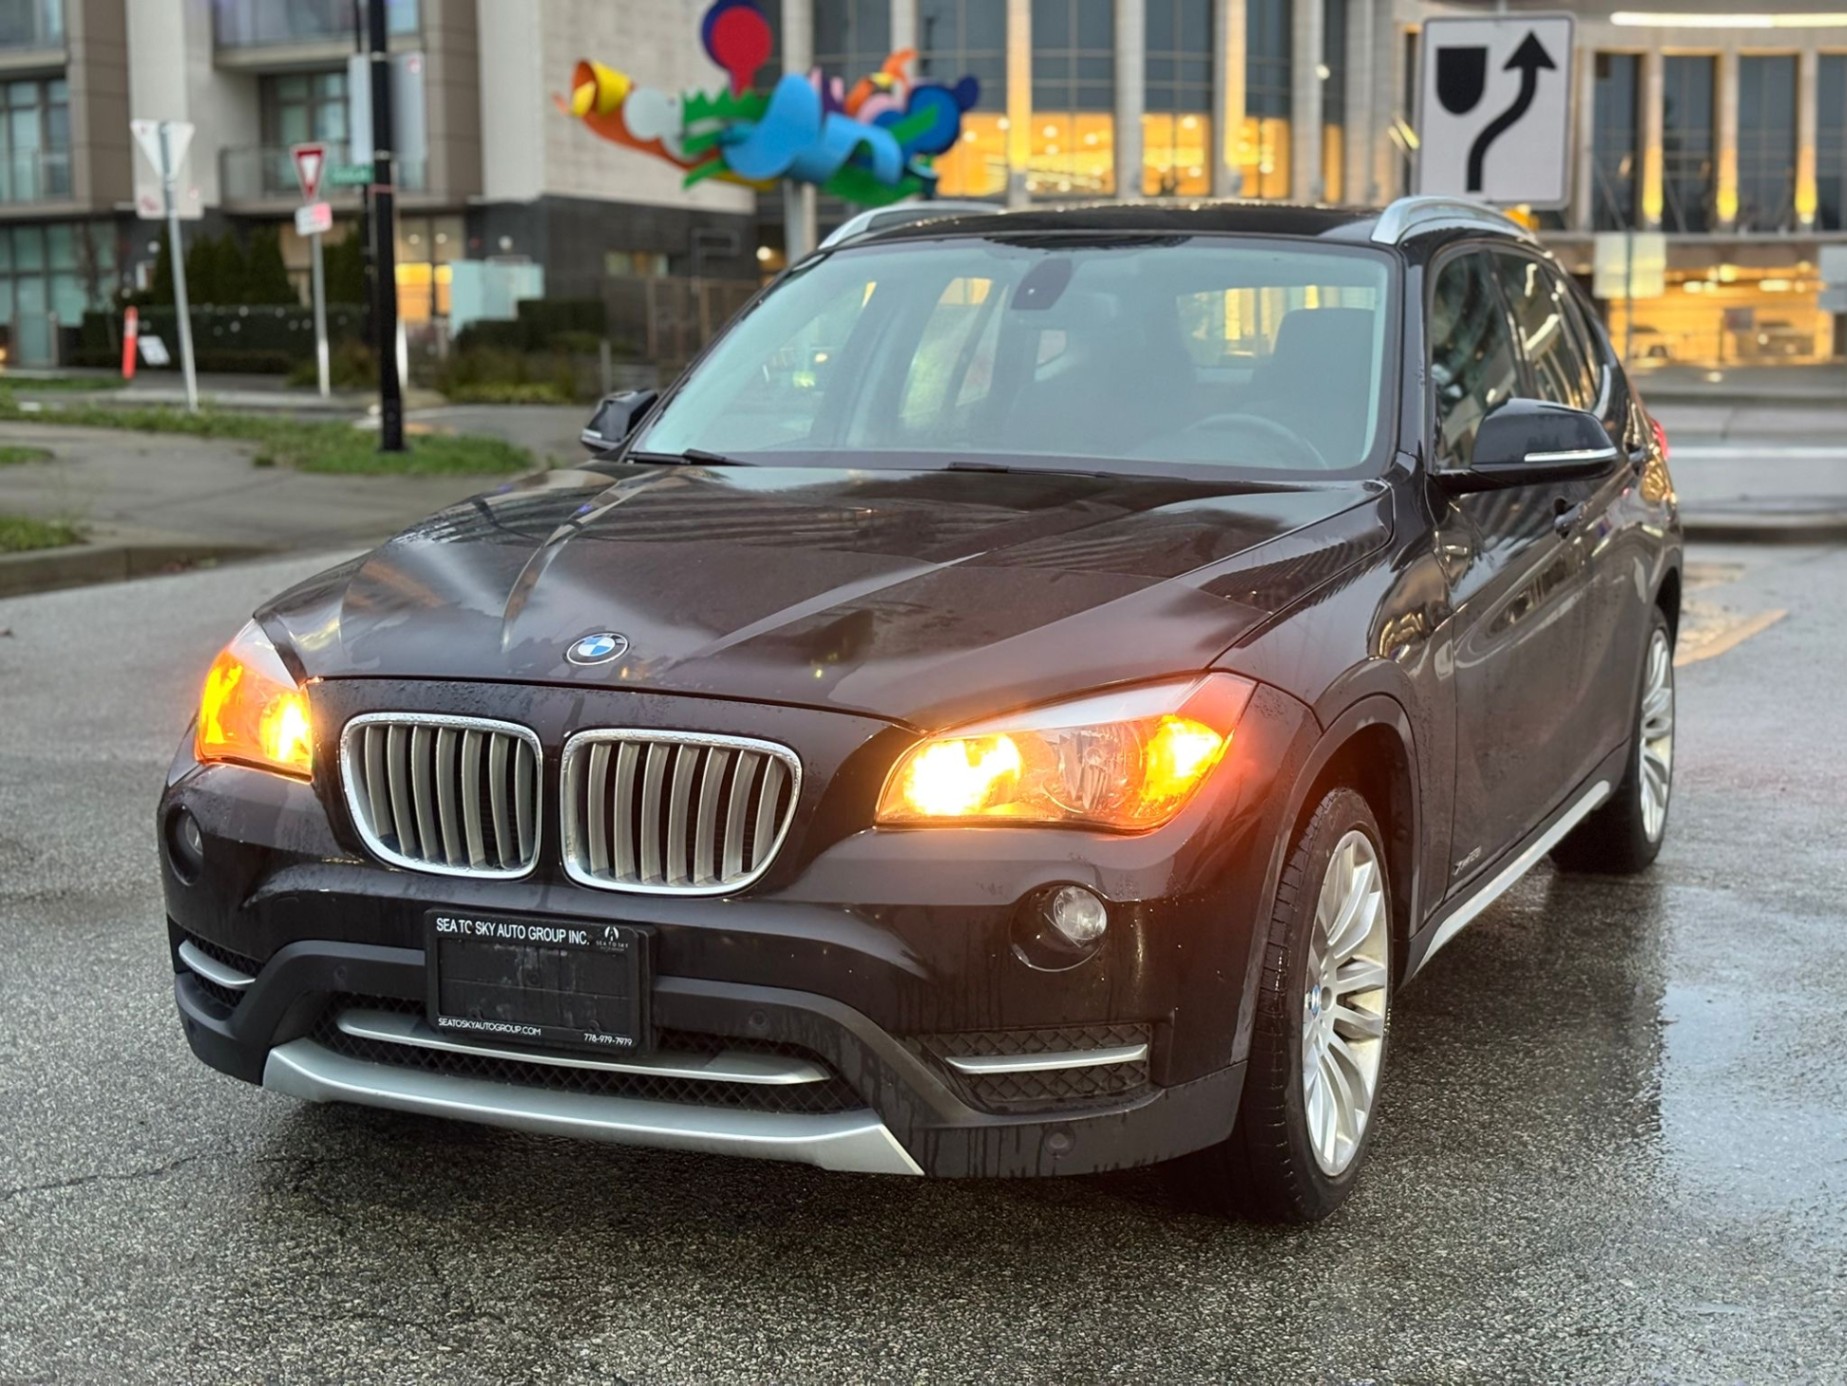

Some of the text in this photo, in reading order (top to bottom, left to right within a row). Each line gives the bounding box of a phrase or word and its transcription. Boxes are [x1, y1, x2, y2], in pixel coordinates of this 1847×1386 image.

[436, 917, 458, 933] SEA
[475, 921, 496, 937] SKY
[497, 923, 526, 940] AUTO
[527, 925, 567, 943] GROUP
[568, 929, 590, 946] INC.
[438, 1017, 542, 1036] SEATOSKYAUTOGROUP.COM
